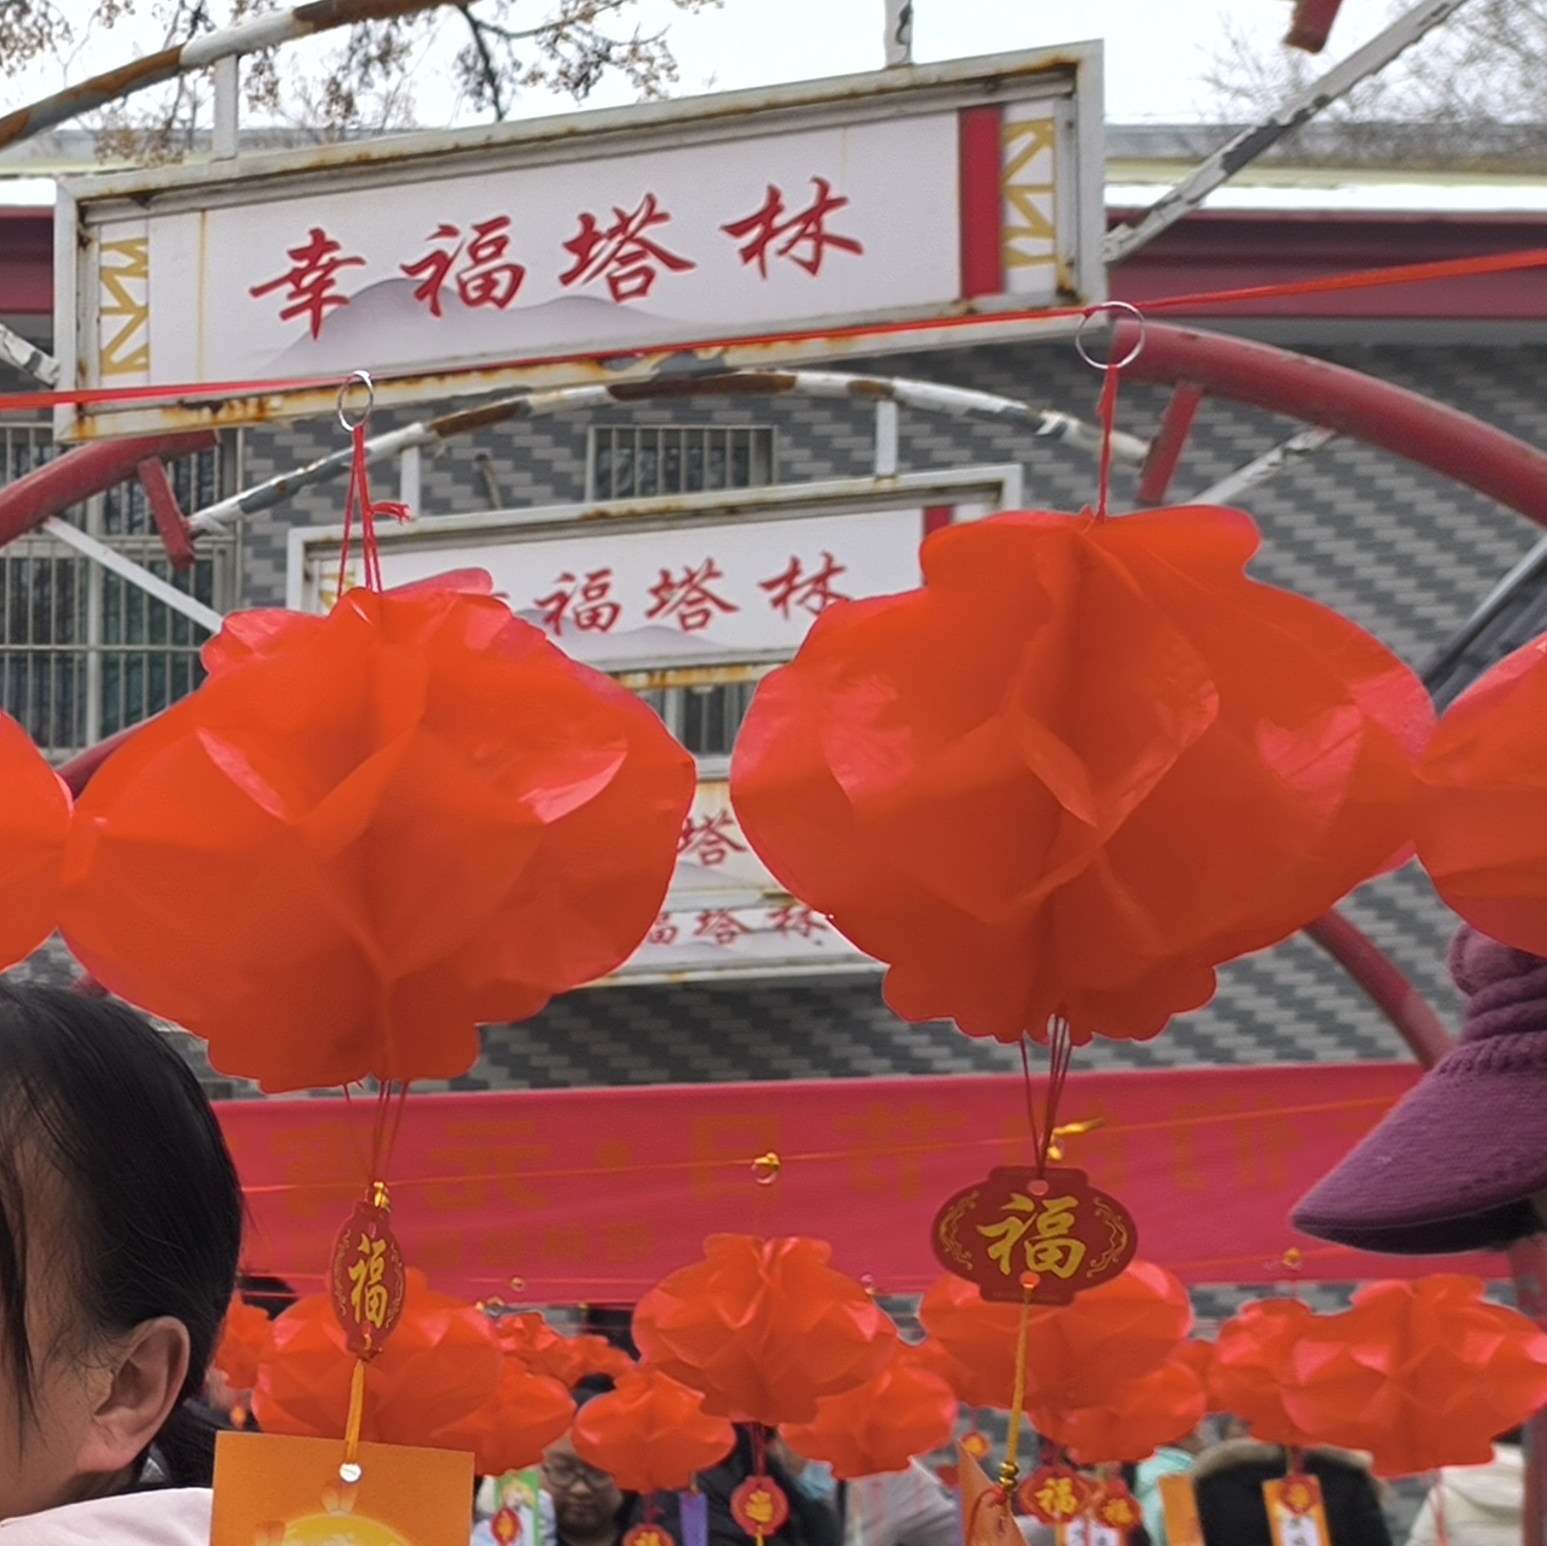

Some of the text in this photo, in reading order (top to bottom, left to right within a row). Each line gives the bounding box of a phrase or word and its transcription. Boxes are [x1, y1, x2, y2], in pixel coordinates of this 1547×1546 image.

[248, 175, 865, 341] 幸福塔林
[507, 550, 853, 637] 福塔林
[347, 1232, 389, 1330] 福
[977, 1192, 1087, 1279] 福
